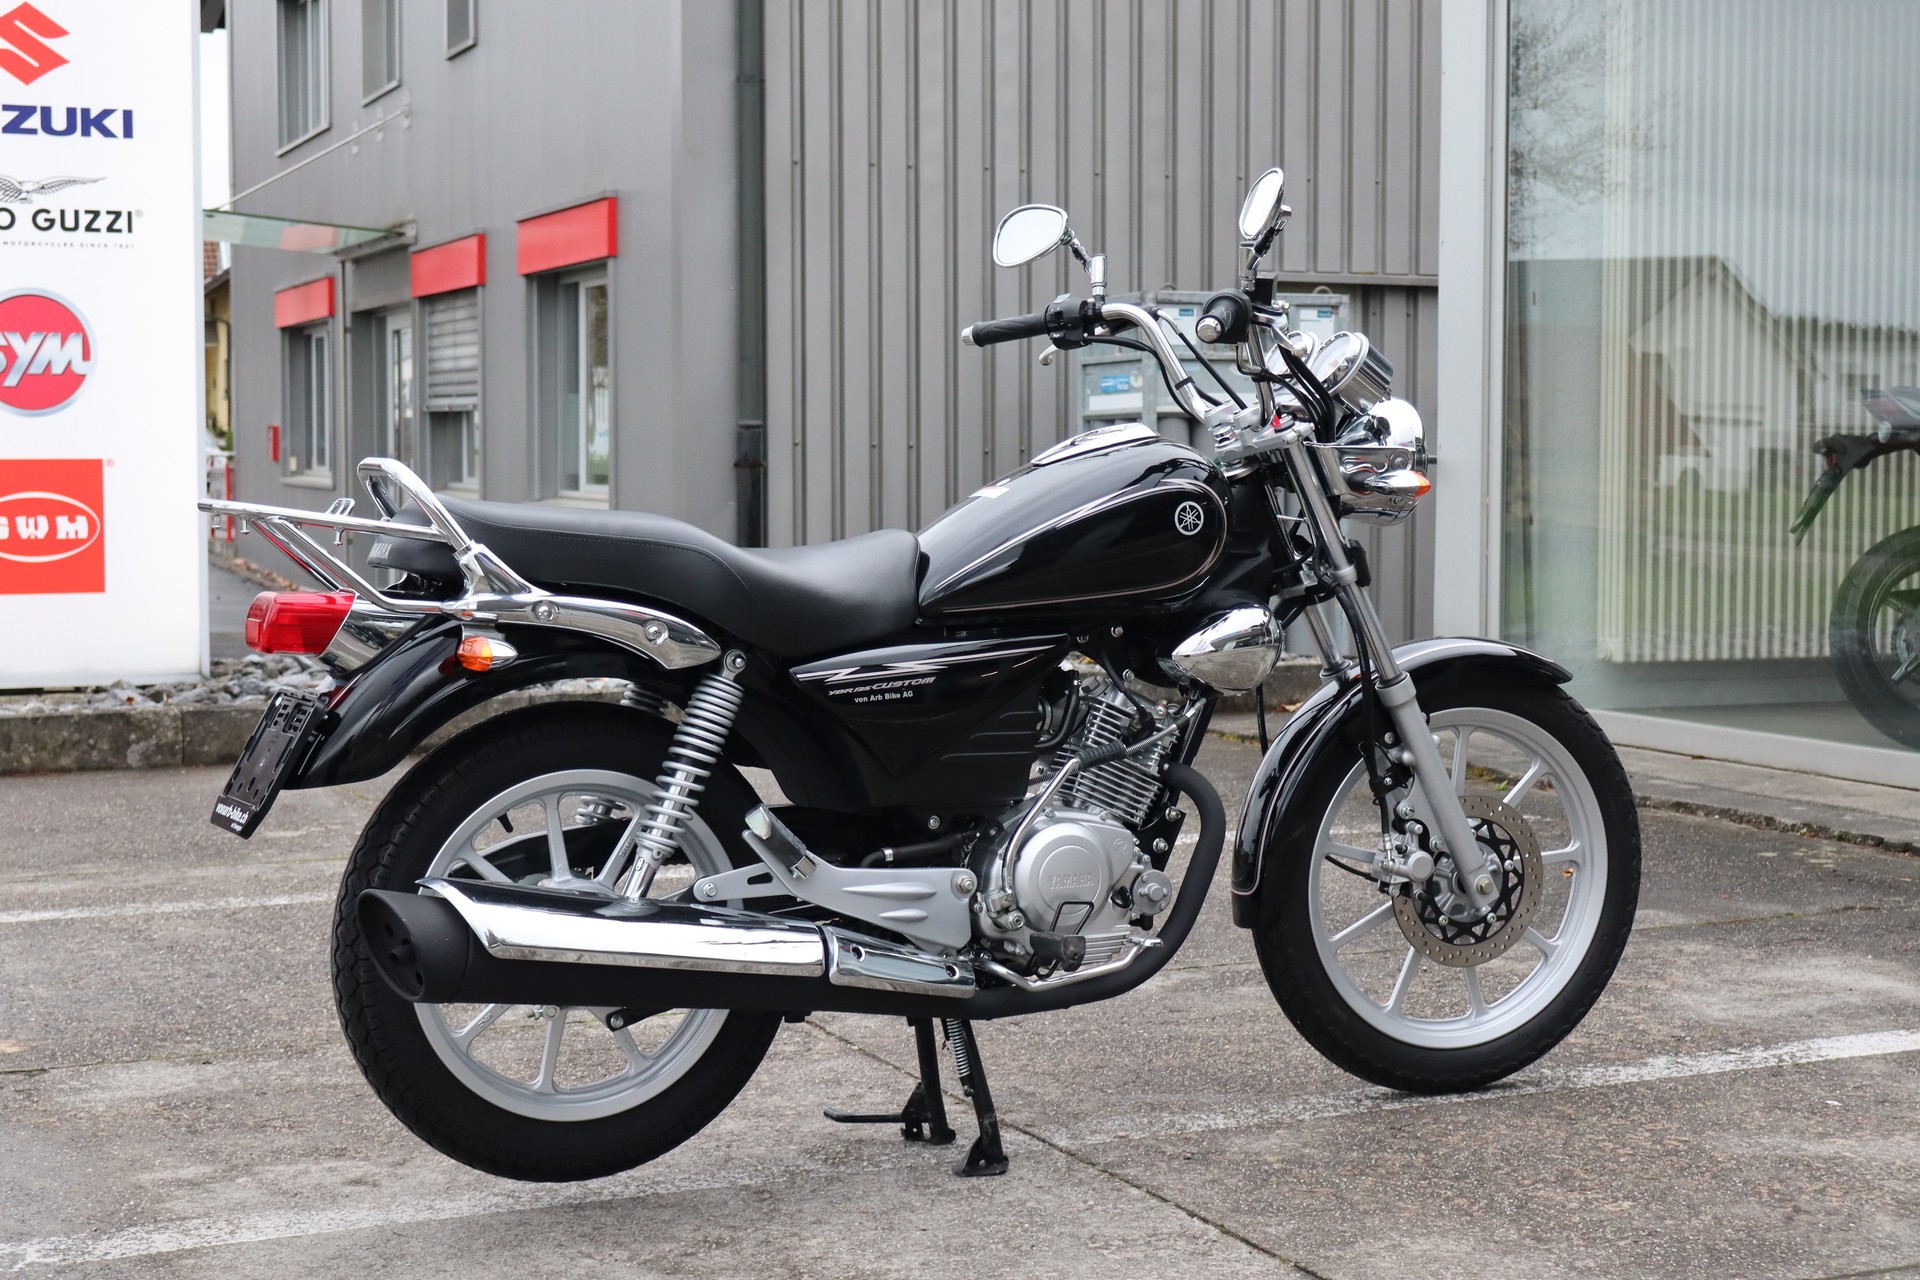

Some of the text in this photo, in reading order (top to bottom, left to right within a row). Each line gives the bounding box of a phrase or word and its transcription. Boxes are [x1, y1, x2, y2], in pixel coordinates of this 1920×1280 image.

[32, 208, 133, 234] GUZZI
[0, 331, 90, 387] YM
[0, 515, 89, 540] WM
[854, 690, 914, 703] von Arb Bike AG
[1049, 873, 1094, 889] YAMAHA
